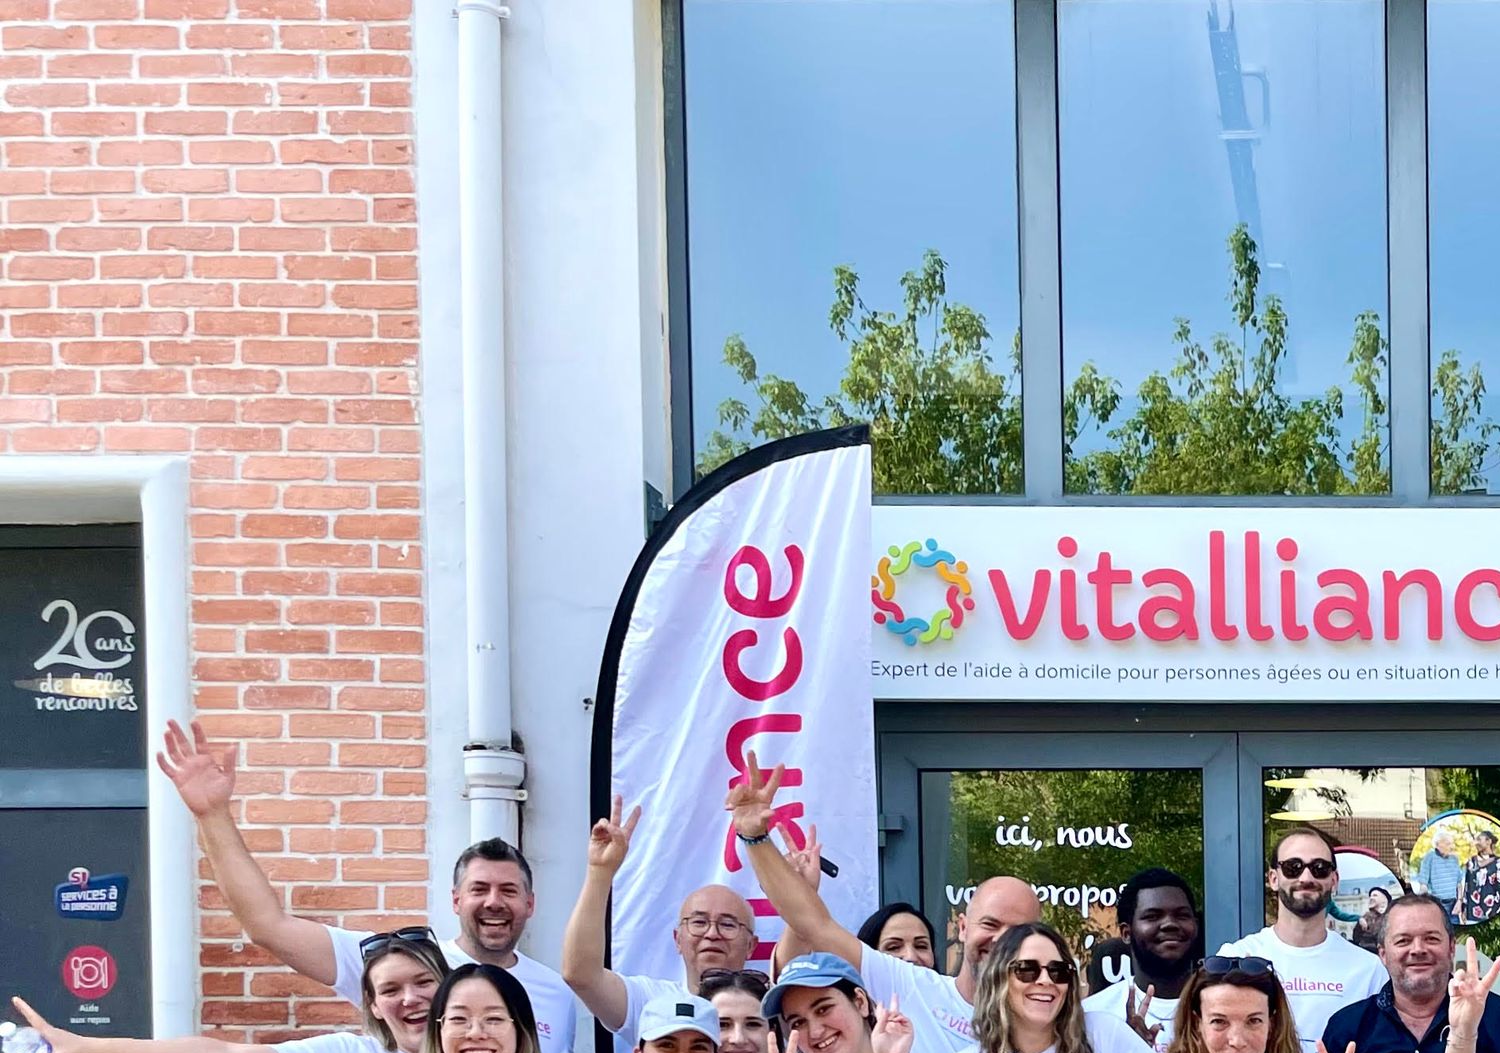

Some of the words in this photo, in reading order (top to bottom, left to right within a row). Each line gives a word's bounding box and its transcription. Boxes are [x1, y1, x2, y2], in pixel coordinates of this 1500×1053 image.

[34, 600, 135, 670] 20
[94, 635, 135, 652] ans
[40, 672, 64, 693] de
[872, 661, 928, 679] Expert
[935, 662, 957, 677] de
[965, 662, 1012, 678] l'aide
[1019, 663, 1028, 678] à
[1035, 664, 1111, 679] domicile
[1118, 668, 1159, 683] pour
[1166, 668, 1260, 683] personnes
[1267, 664, 1321, 683] âgées
[1328, 668, 1349, 680] ou
[1357, 668, 1378, 680] en
[1385, 665, 1459, 680] situation
[1467, 664, 1488, 679] de
[35, 694, 138, 712] rencontres
[995, 815, 1043, 851] ici,
[1057, 823, 1133, 849] nous
[79, 1004, 99, 1013] Aide
[87, 1017, 111, 1025] repas
